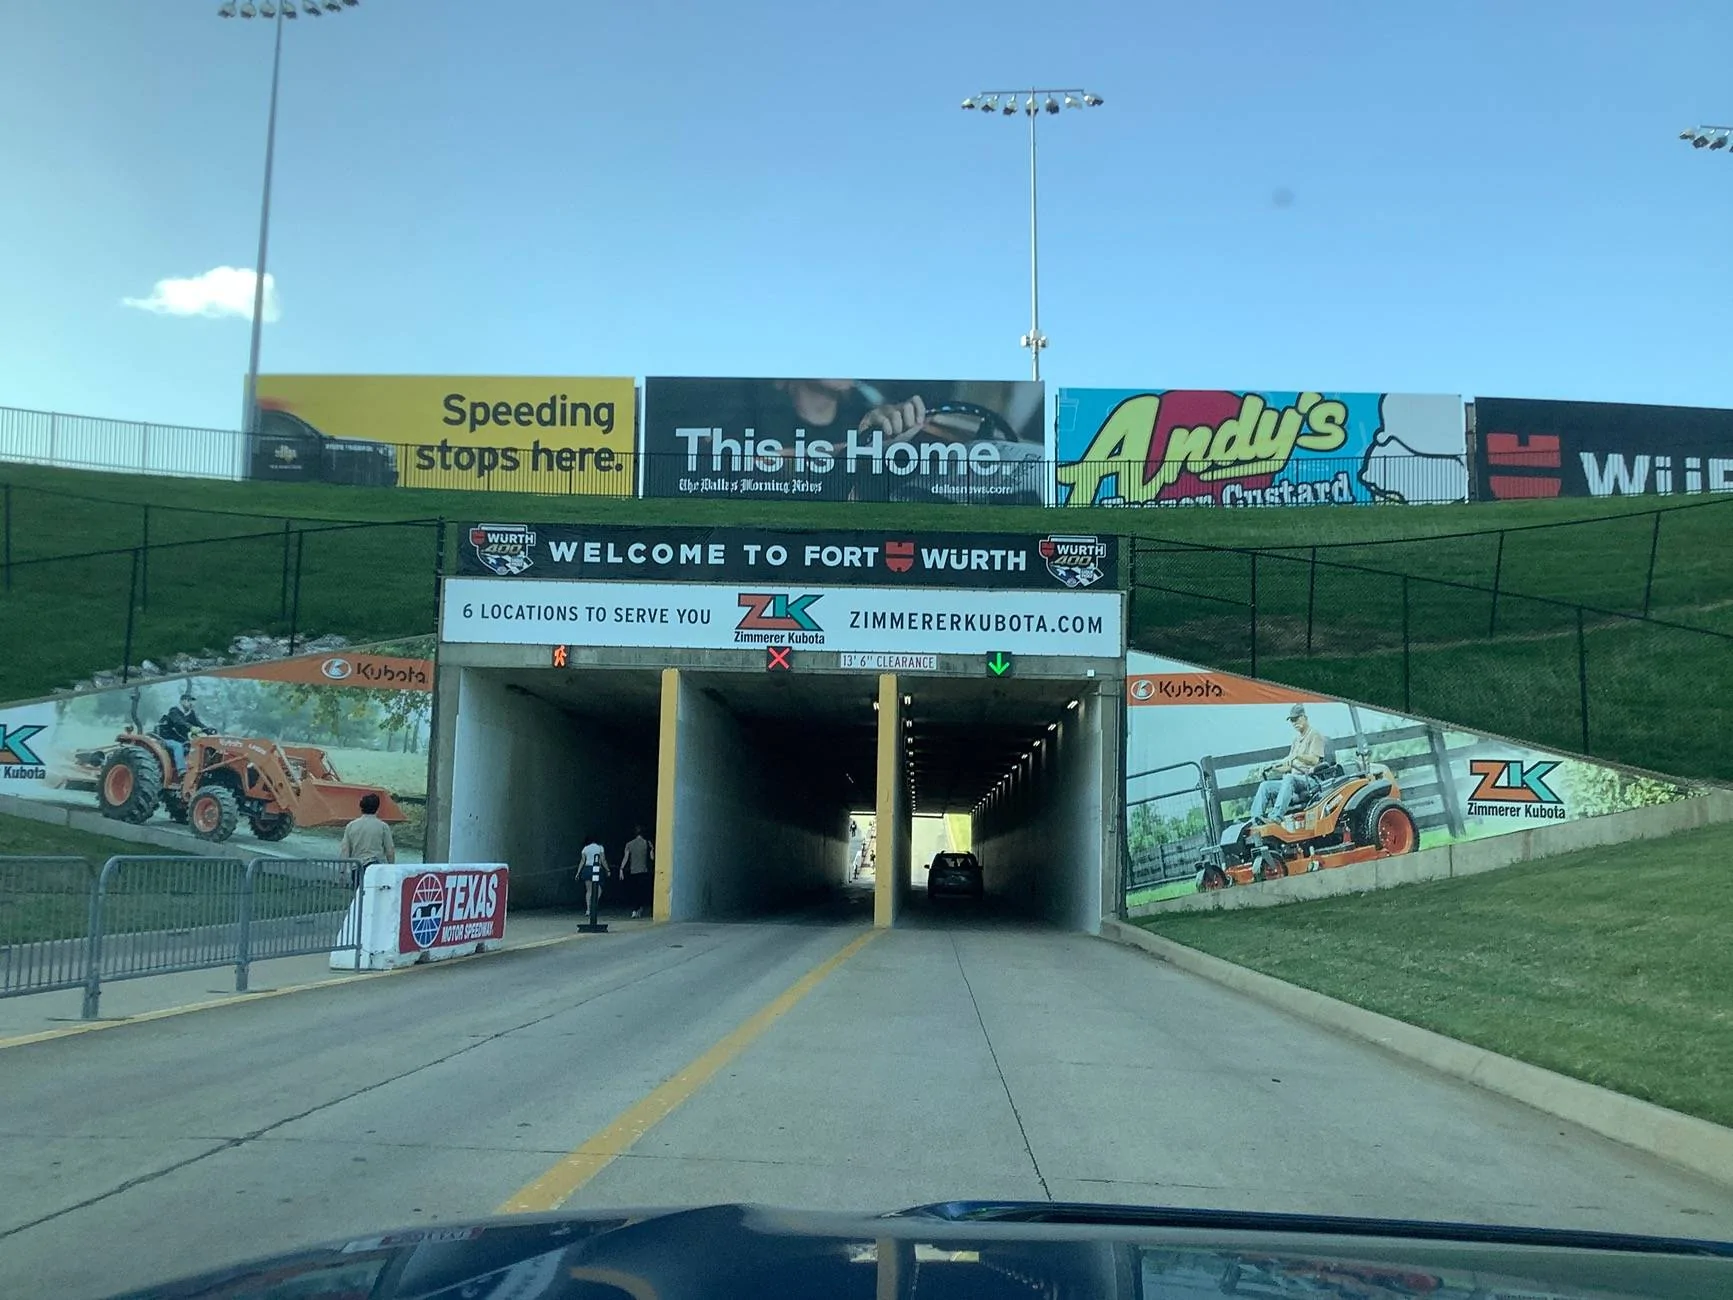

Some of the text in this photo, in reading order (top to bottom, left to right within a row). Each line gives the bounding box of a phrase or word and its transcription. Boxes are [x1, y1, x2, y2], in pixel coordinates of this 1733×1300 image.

[442, 393, 615, 434] Speeding
[416, 439, 624, 477] stops here.
[675, 427, 785, 473] This
[795, 428, 836, 473] is
[1057, 391, 1348, 507] Andy's
[679, 478, 700, 493] The
[740, 479, 789, 494] Morning
[792, 479, 822, 494] News
[1220, 471, 1354, 505] Custard
[484, 544, 523, 554] 400
[549, 541, 726, 566] WELCOME
[744, 544, 788, 567] TO
[804, 546, 879, 569] FORT
[1054, 555, 1092, 566] 400
[462, 603, 711, 625] 6 LOCATIONS TO SERVE YOU
[736, 592, 825, 632] ZK
[849, 611, 1103, 635] ZIMMERERKUBOTA.COM
[734, 631, 825, 645] Zimmerer Kubota
[357, 662, 425, 684] Kubota
[842, 655, 856, 667] 13'
[876, 656, 935, 669] CLEARANCE
[1159, 680, 1222, 698] Kubota
[4, 765, 46, 779] Kubota
[1467, 759, 1564, 804] ZK
[1467, 802, 1566, 820] Zimmerer Kubota
[444, 873, 499, 922] TEXAS
[441, 921, 494, 943] MOTOR SPEEDWAY
